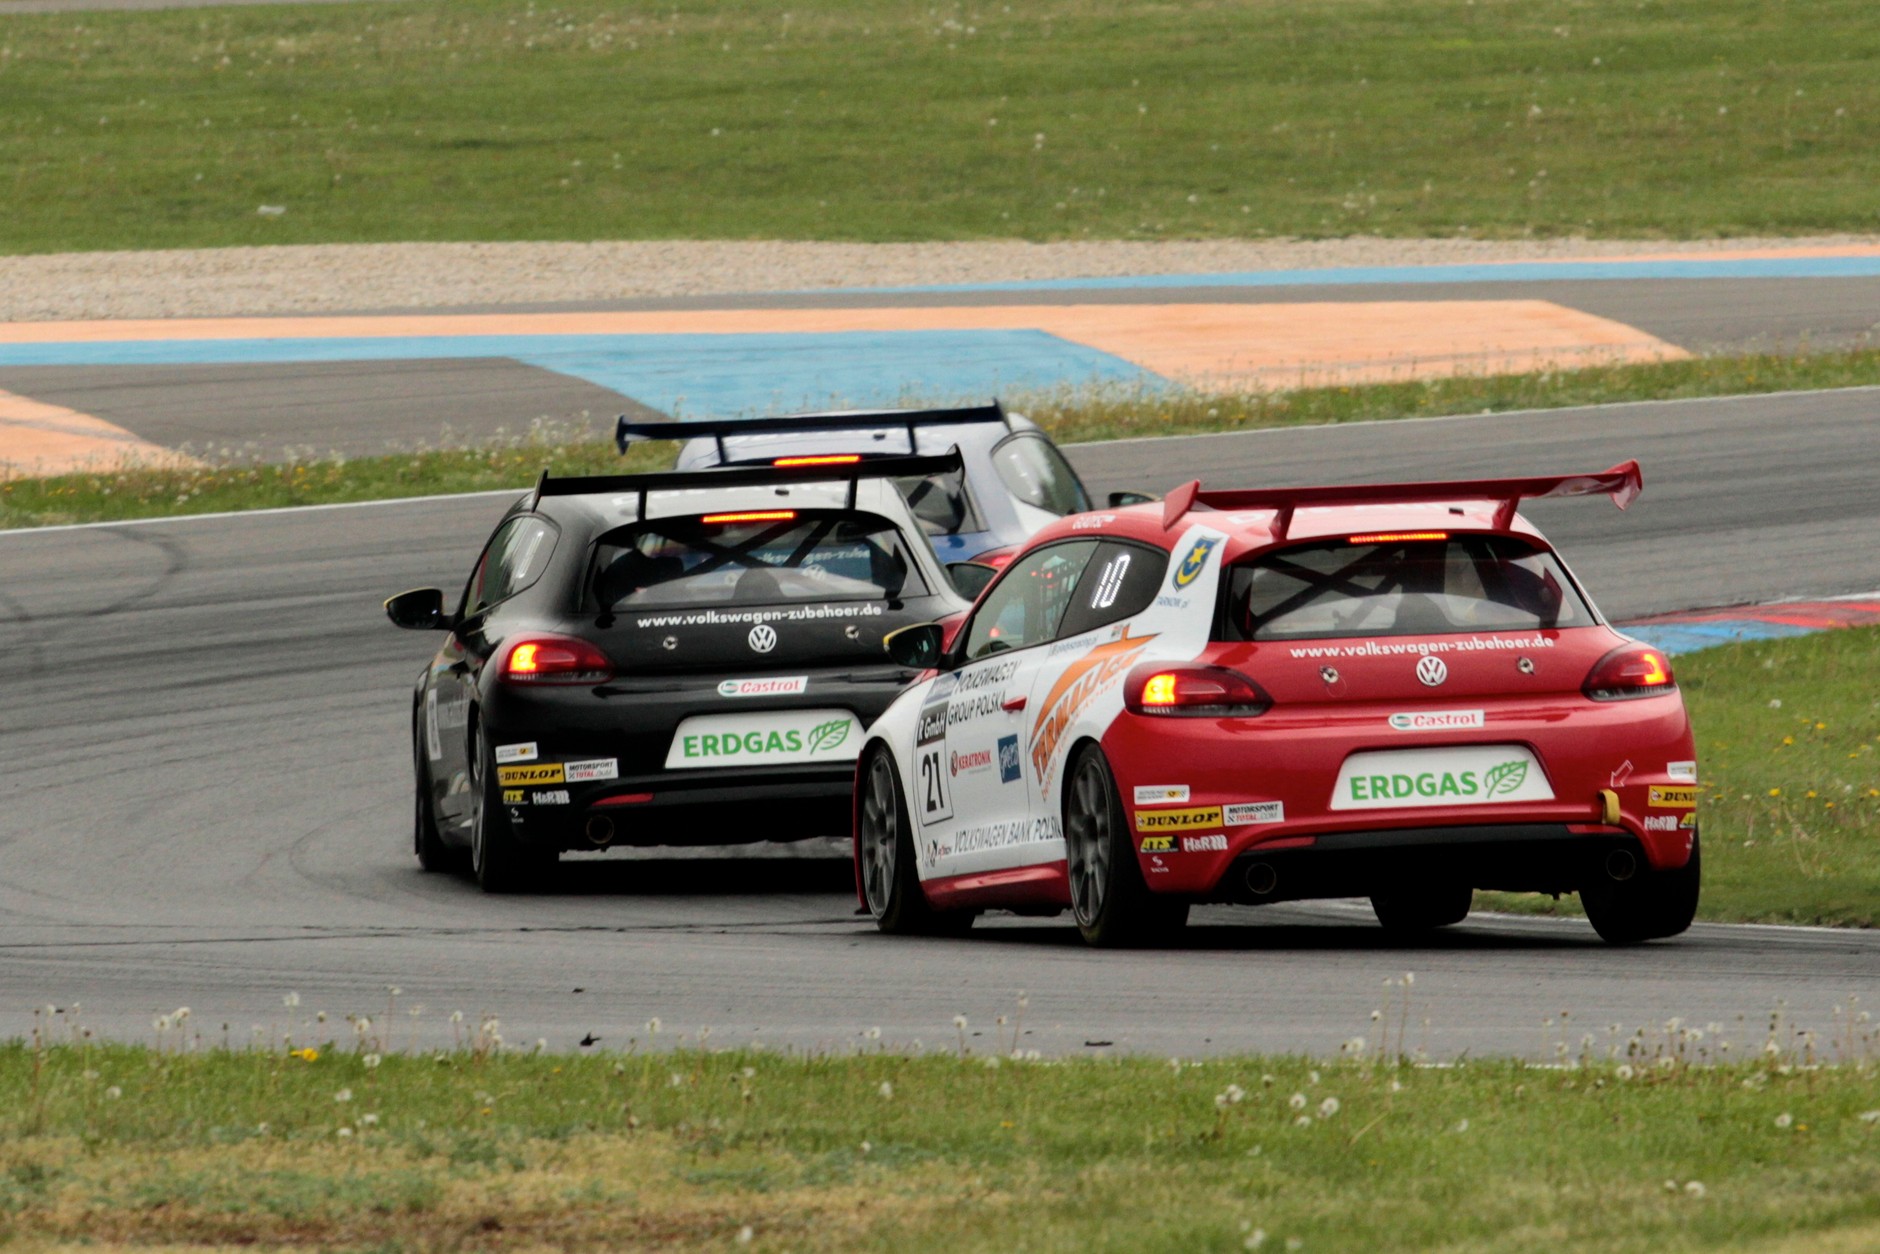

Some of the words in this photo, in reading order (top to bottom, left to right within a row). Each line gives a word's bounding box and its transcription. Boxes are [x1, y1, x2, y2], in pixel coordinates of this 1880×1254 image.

[637, 603, 882, 628] www.volkswagen-zubehoer.de
[1290, 634, 1554, 658] www.volkswagen-zubehoer.de
[739, 678, 800, 694] Castrol
[954, 659, 1022, 694] VOLKSWAGEN
[948, 700, 974, 726] GROUP
[975, 690, 1006, 719] POLSKA
[924, 711, 946, 739] GmbH
[1413, 713, 1478, 728] Castrol
[683, 730, 803, 758] ERDGAS
[569, 762, 614, 771] MOTORSPORT
[957, 749, 992, 771] KERATRONIK
[504, 769, 561, 781] DUNLOP
[922, 751, 945, 813] 21
[1350, 771, 1479, 801] ERDGAS
[1146, 812, 1220, 826] DUNLOP
[1228, 803, 1280, 814] MOTORSPORT
[954, 822, 1009, 854] VOLKSWAGEN
[1007, 818, 1035, 845] BANK
